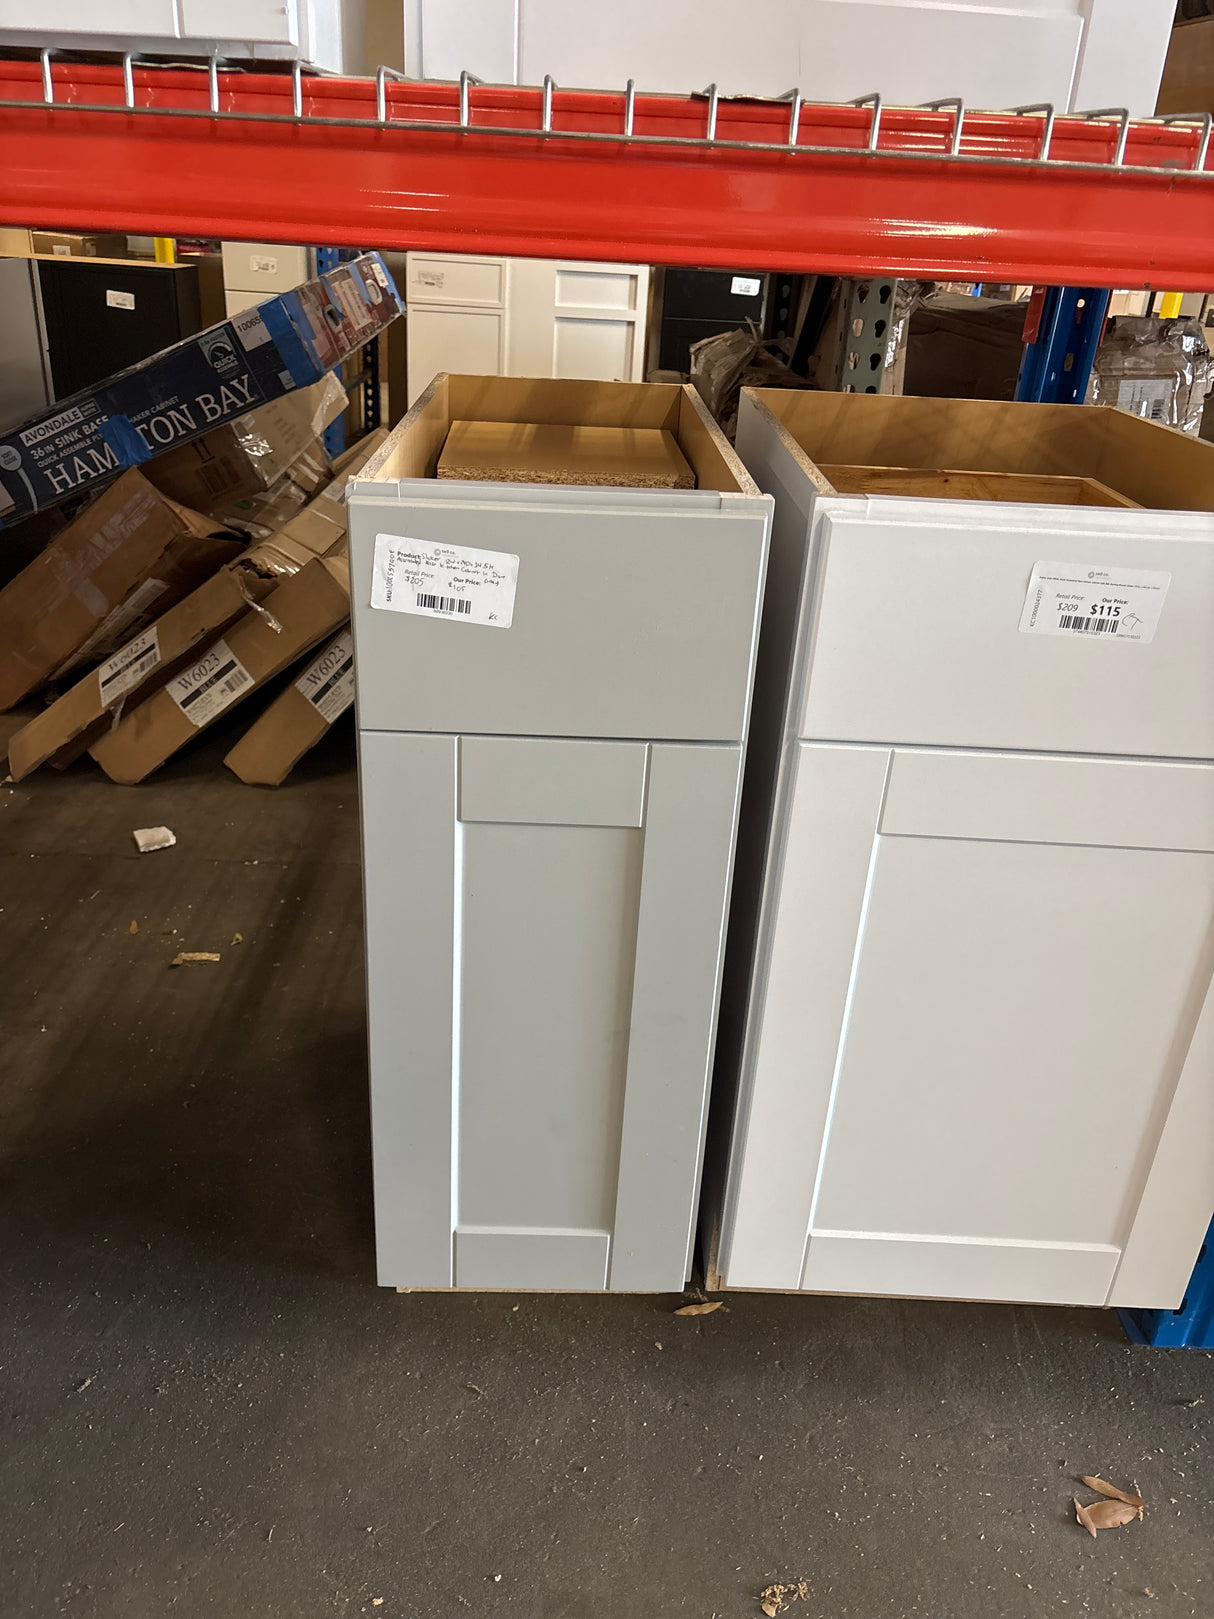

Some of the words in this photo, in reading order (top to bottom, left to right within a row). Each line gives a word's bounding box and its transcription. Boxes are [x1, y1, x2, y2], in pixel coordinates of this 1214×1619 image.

[213, 354, 237, 368] QUICK
[195, 375, 257, 423] BAY
[24, 410, 81, 444] AVONDALE
[37, 455, 59, 468] QUICK
[59, 438, 92, 459] ASSEMBLE
[151, 395, 179, 413] CABINET
[55, 430, 82, 448] SINK
[1057, 602, 1079, 612] $209
[1090, 603, 1121, 617] $115
[108, 637, 147, 671] W6023
[306, 646, 346, 687] W6023
[178, 653, 221, 691] W6023
